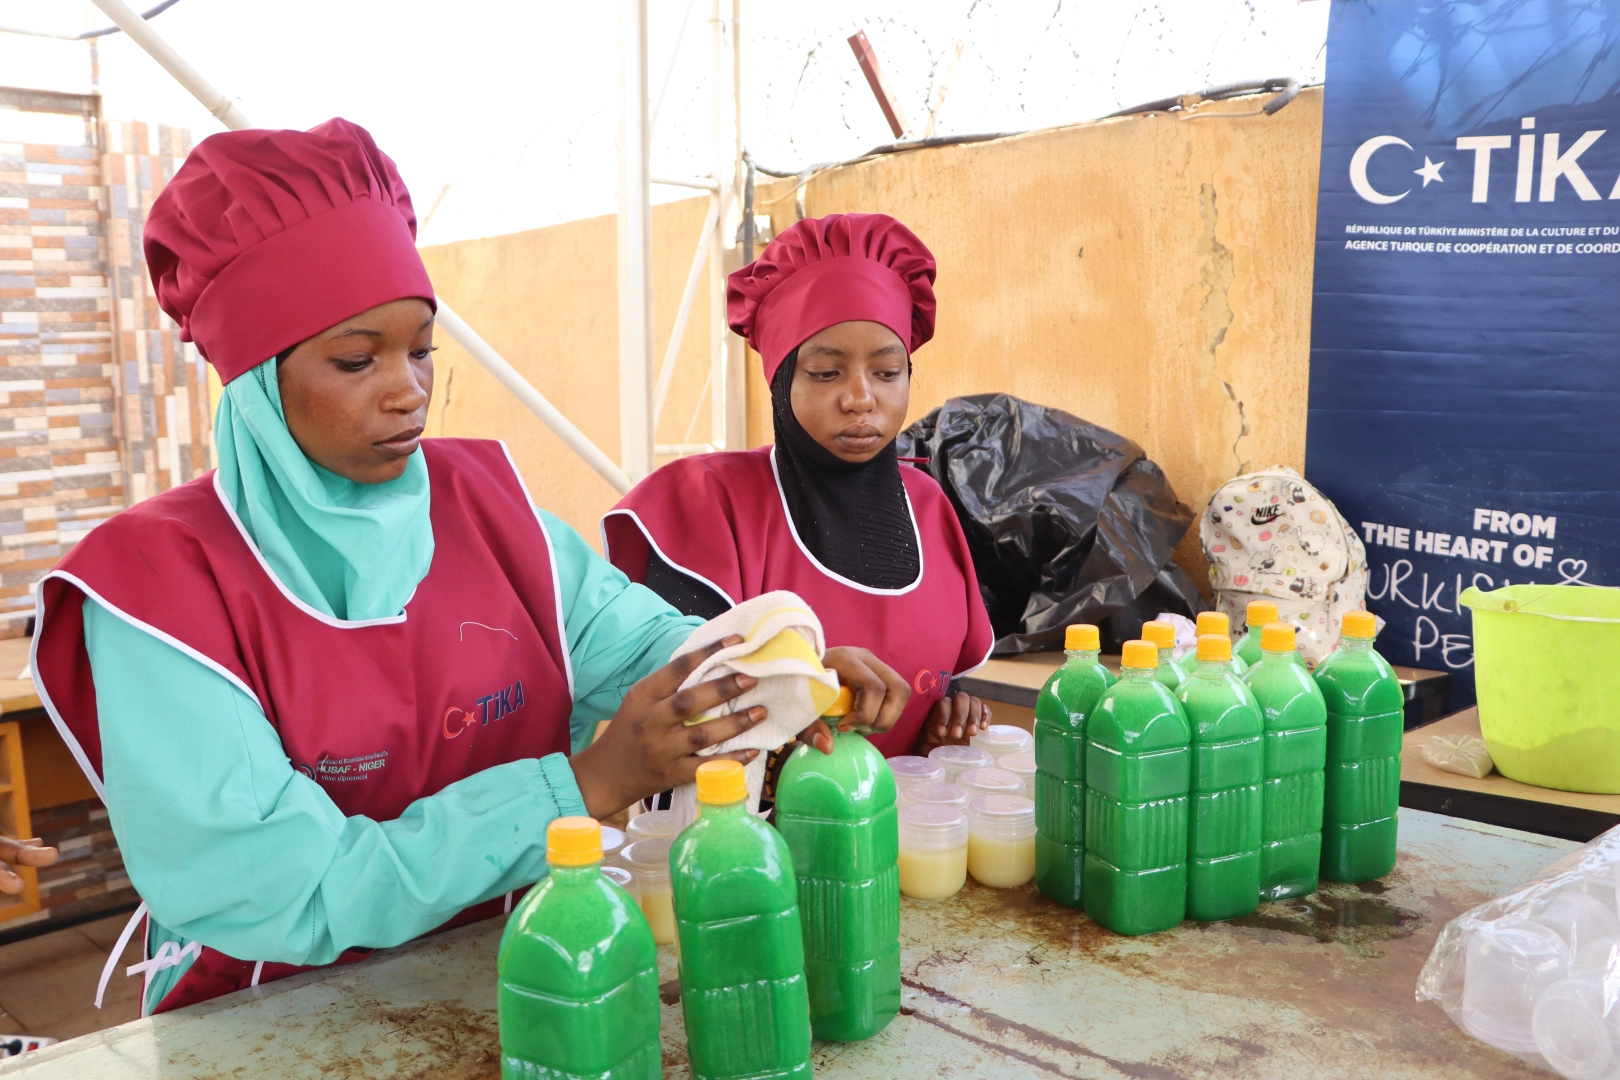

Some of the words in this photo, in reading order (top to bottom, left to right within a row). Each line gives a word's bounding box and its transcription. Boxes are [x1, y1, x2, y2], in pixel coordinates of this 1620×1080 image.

[1456, 117, 1620, 203] TİK
[1345, 224, 1402, 235] RÉPUBLIQUE
[1403, 226, 1416, 235] DE
[1418, 225, 1457, 236] TÜRKİYE
[1511, 228, 1524, 237] DE
[1526, 228, 1539, 237] LA
[1541, 227, 1586, 237] CULTURE
[1588, 226, 1601, 236] ET
[1603, 226, 1619, 236] DU
[1345, 240, 1388, 251] AGENCE
[1389, 241, 1434, 253] TURQUE
[1436, 242, 1451, 253] DE
[1454, 241, 1537, 254] COOPÉRATION
[1539, 243, 1554, 254] ET
[1556, 243, 1573, 254] DE
[1255, 503, 1280, 517] NIKE
[1473, 508, 1556, 539] FROM
[1361, 521, 1410, 550] THE
[1414, 530, 1508, 563] HEART
[1513, 543, 1554, 569] OF
[358, 759, 385, 772] NIGER
